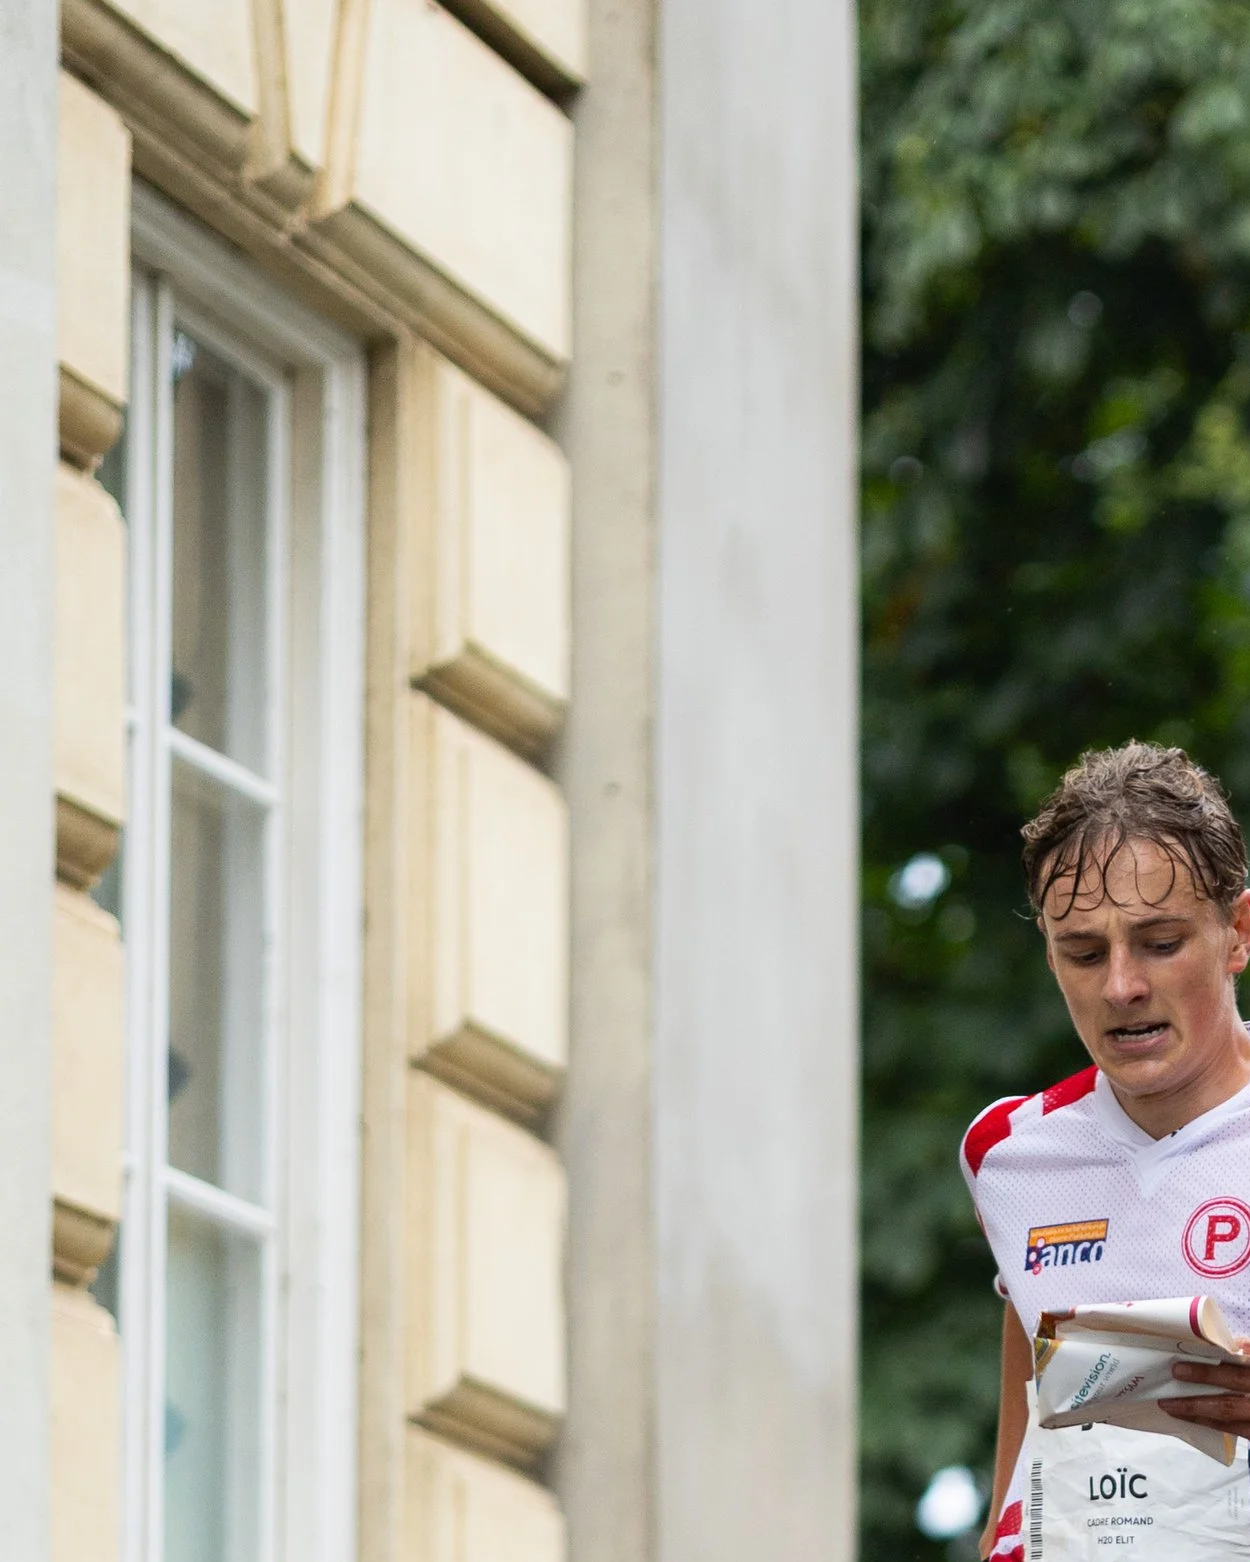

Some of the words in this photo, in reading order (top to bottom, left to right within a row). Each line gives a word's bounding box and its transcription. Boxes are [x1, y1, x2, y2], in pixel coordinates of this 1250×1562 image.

[1203, 1214, 1241, 1261] P
[1089, 1467, 1149, 1501] LOÏC
[1087, 1517, 1110, 1528] CADRE
[1111, 1516, 1154, 1526] ROMAND
[1097, 1536, 1113, 1545] H20
[1115, 1535, 1135, 1545] ELIT
